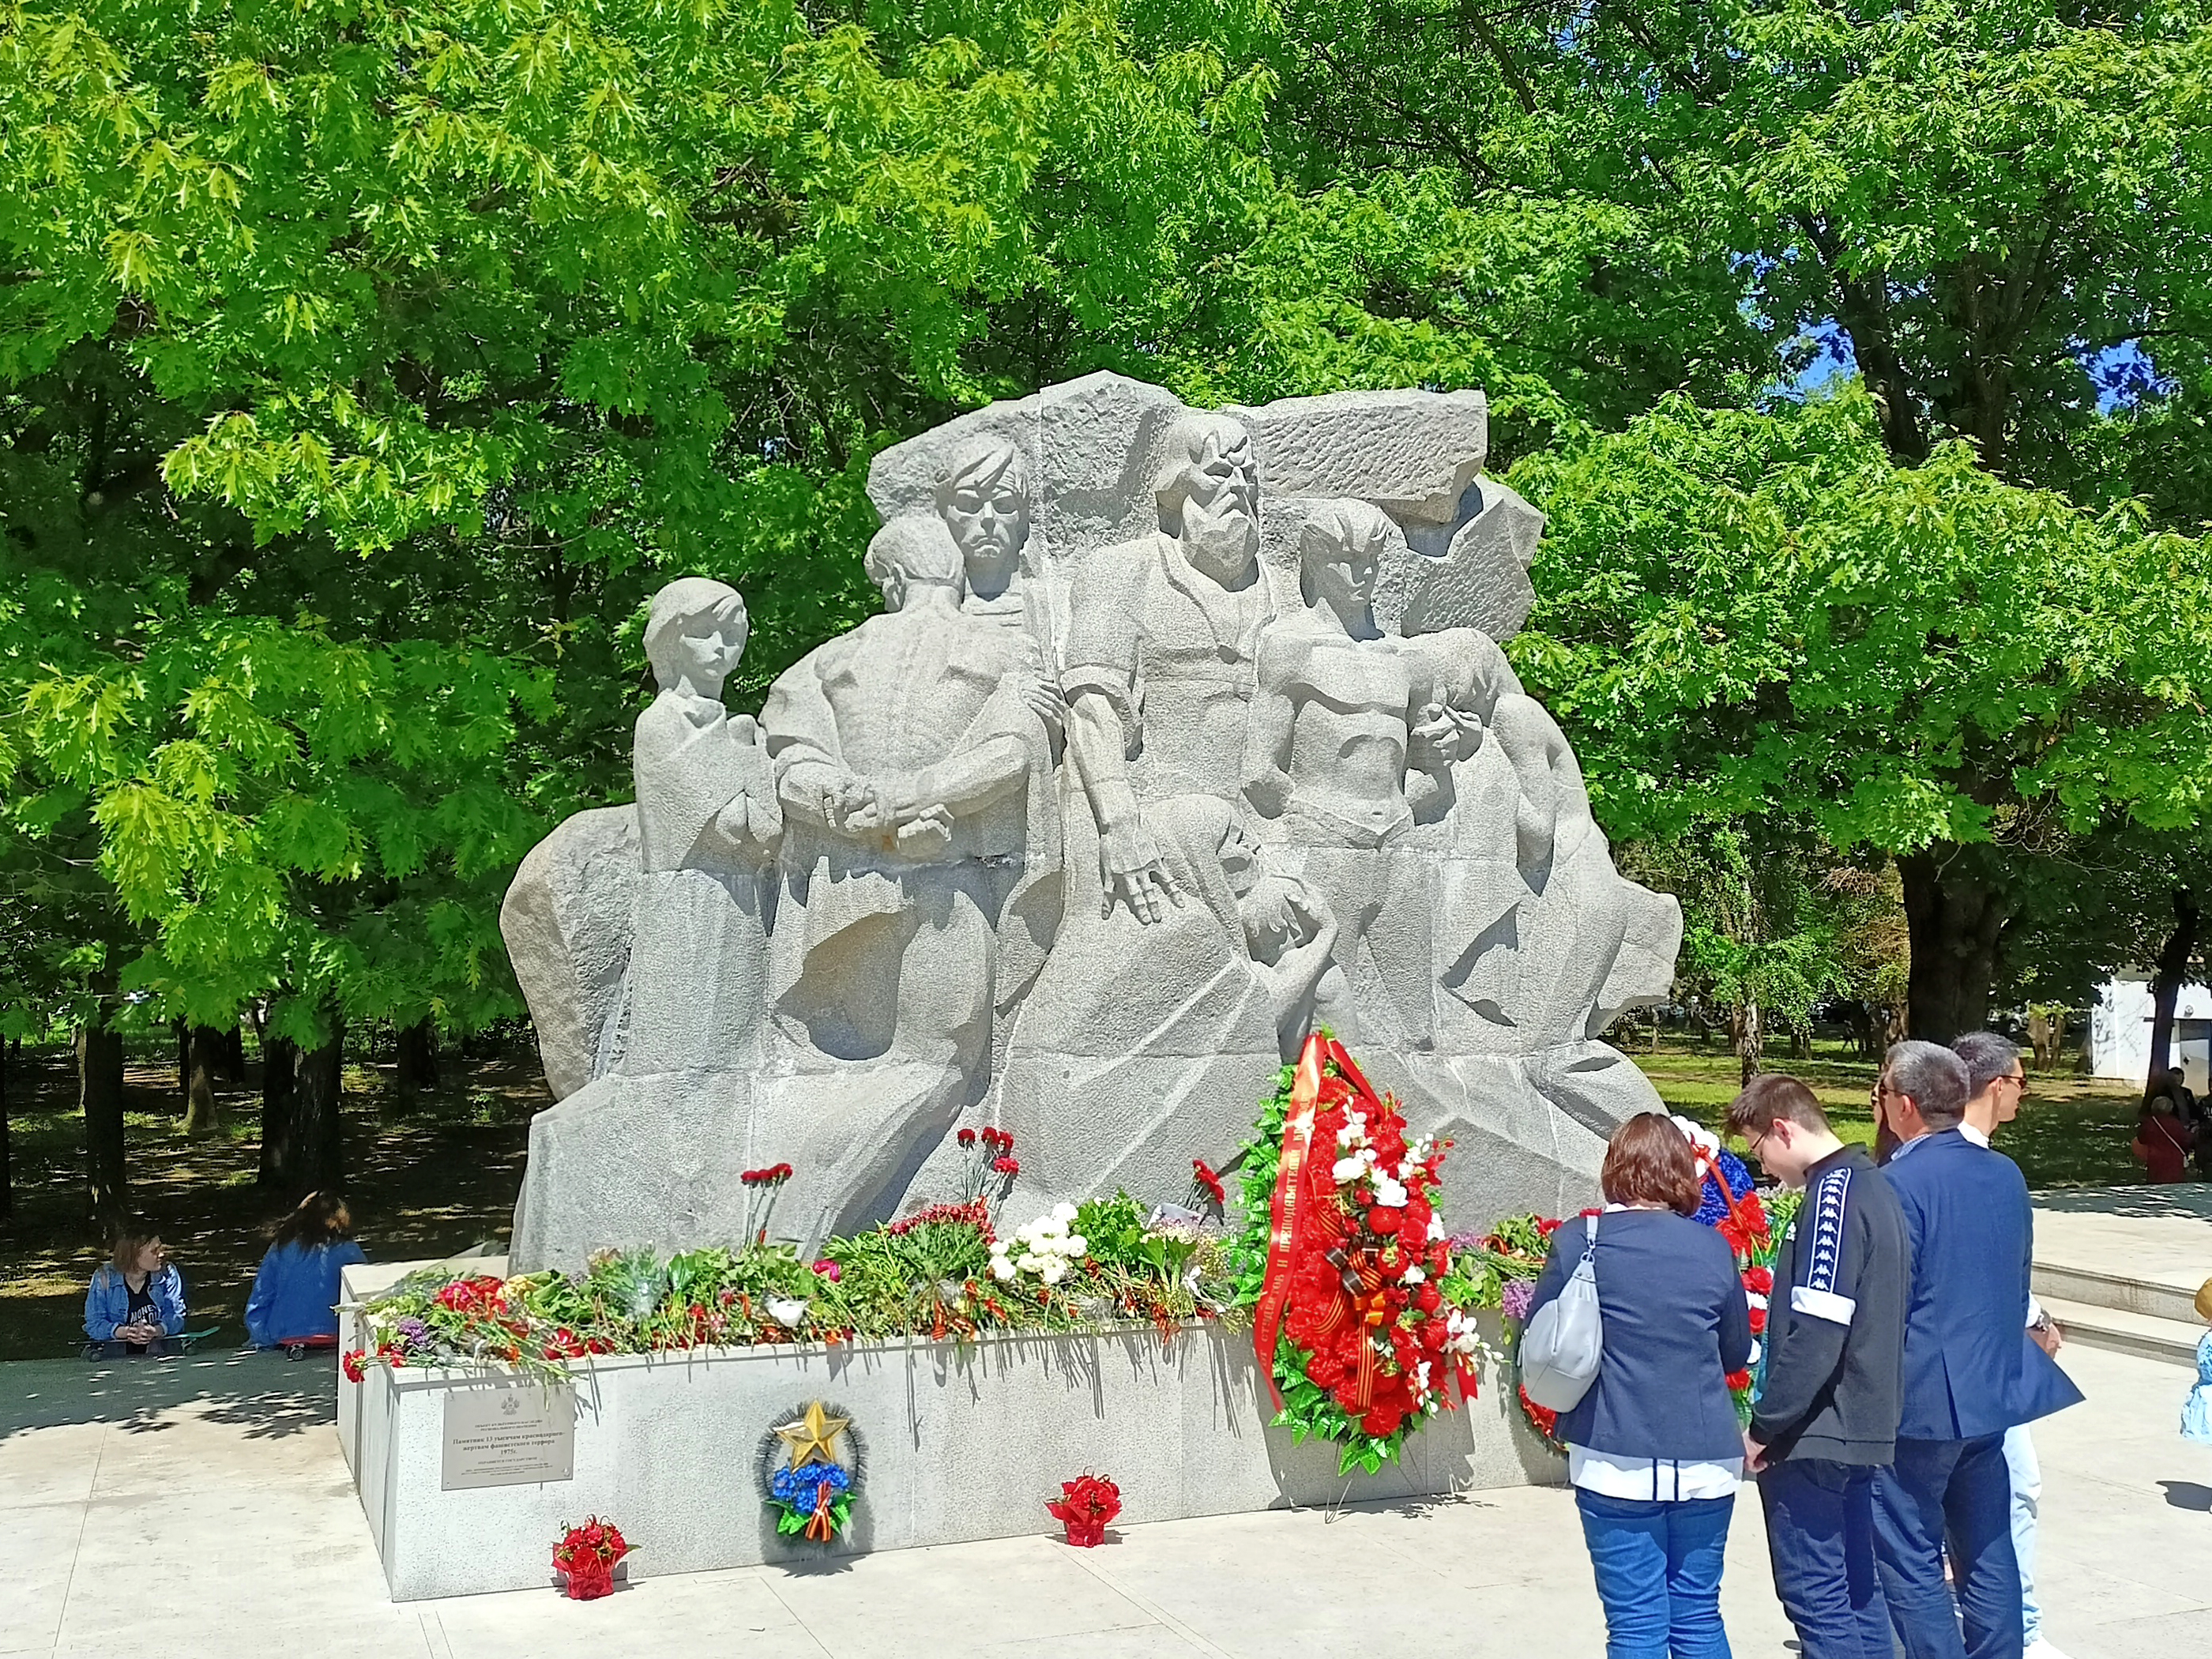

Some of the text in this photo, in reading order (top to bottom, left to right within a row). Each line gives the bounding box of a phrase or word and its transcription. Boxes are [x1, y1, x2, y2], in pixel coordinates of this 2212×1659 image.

[1261, 1273, 1285, 1342] СТУДЕНТОВ
[1279, 1149, 1301, 1253] ПРЕПОДАВАТЕЛЕЙ
[490, 1441, 530, 1450] фашистского
